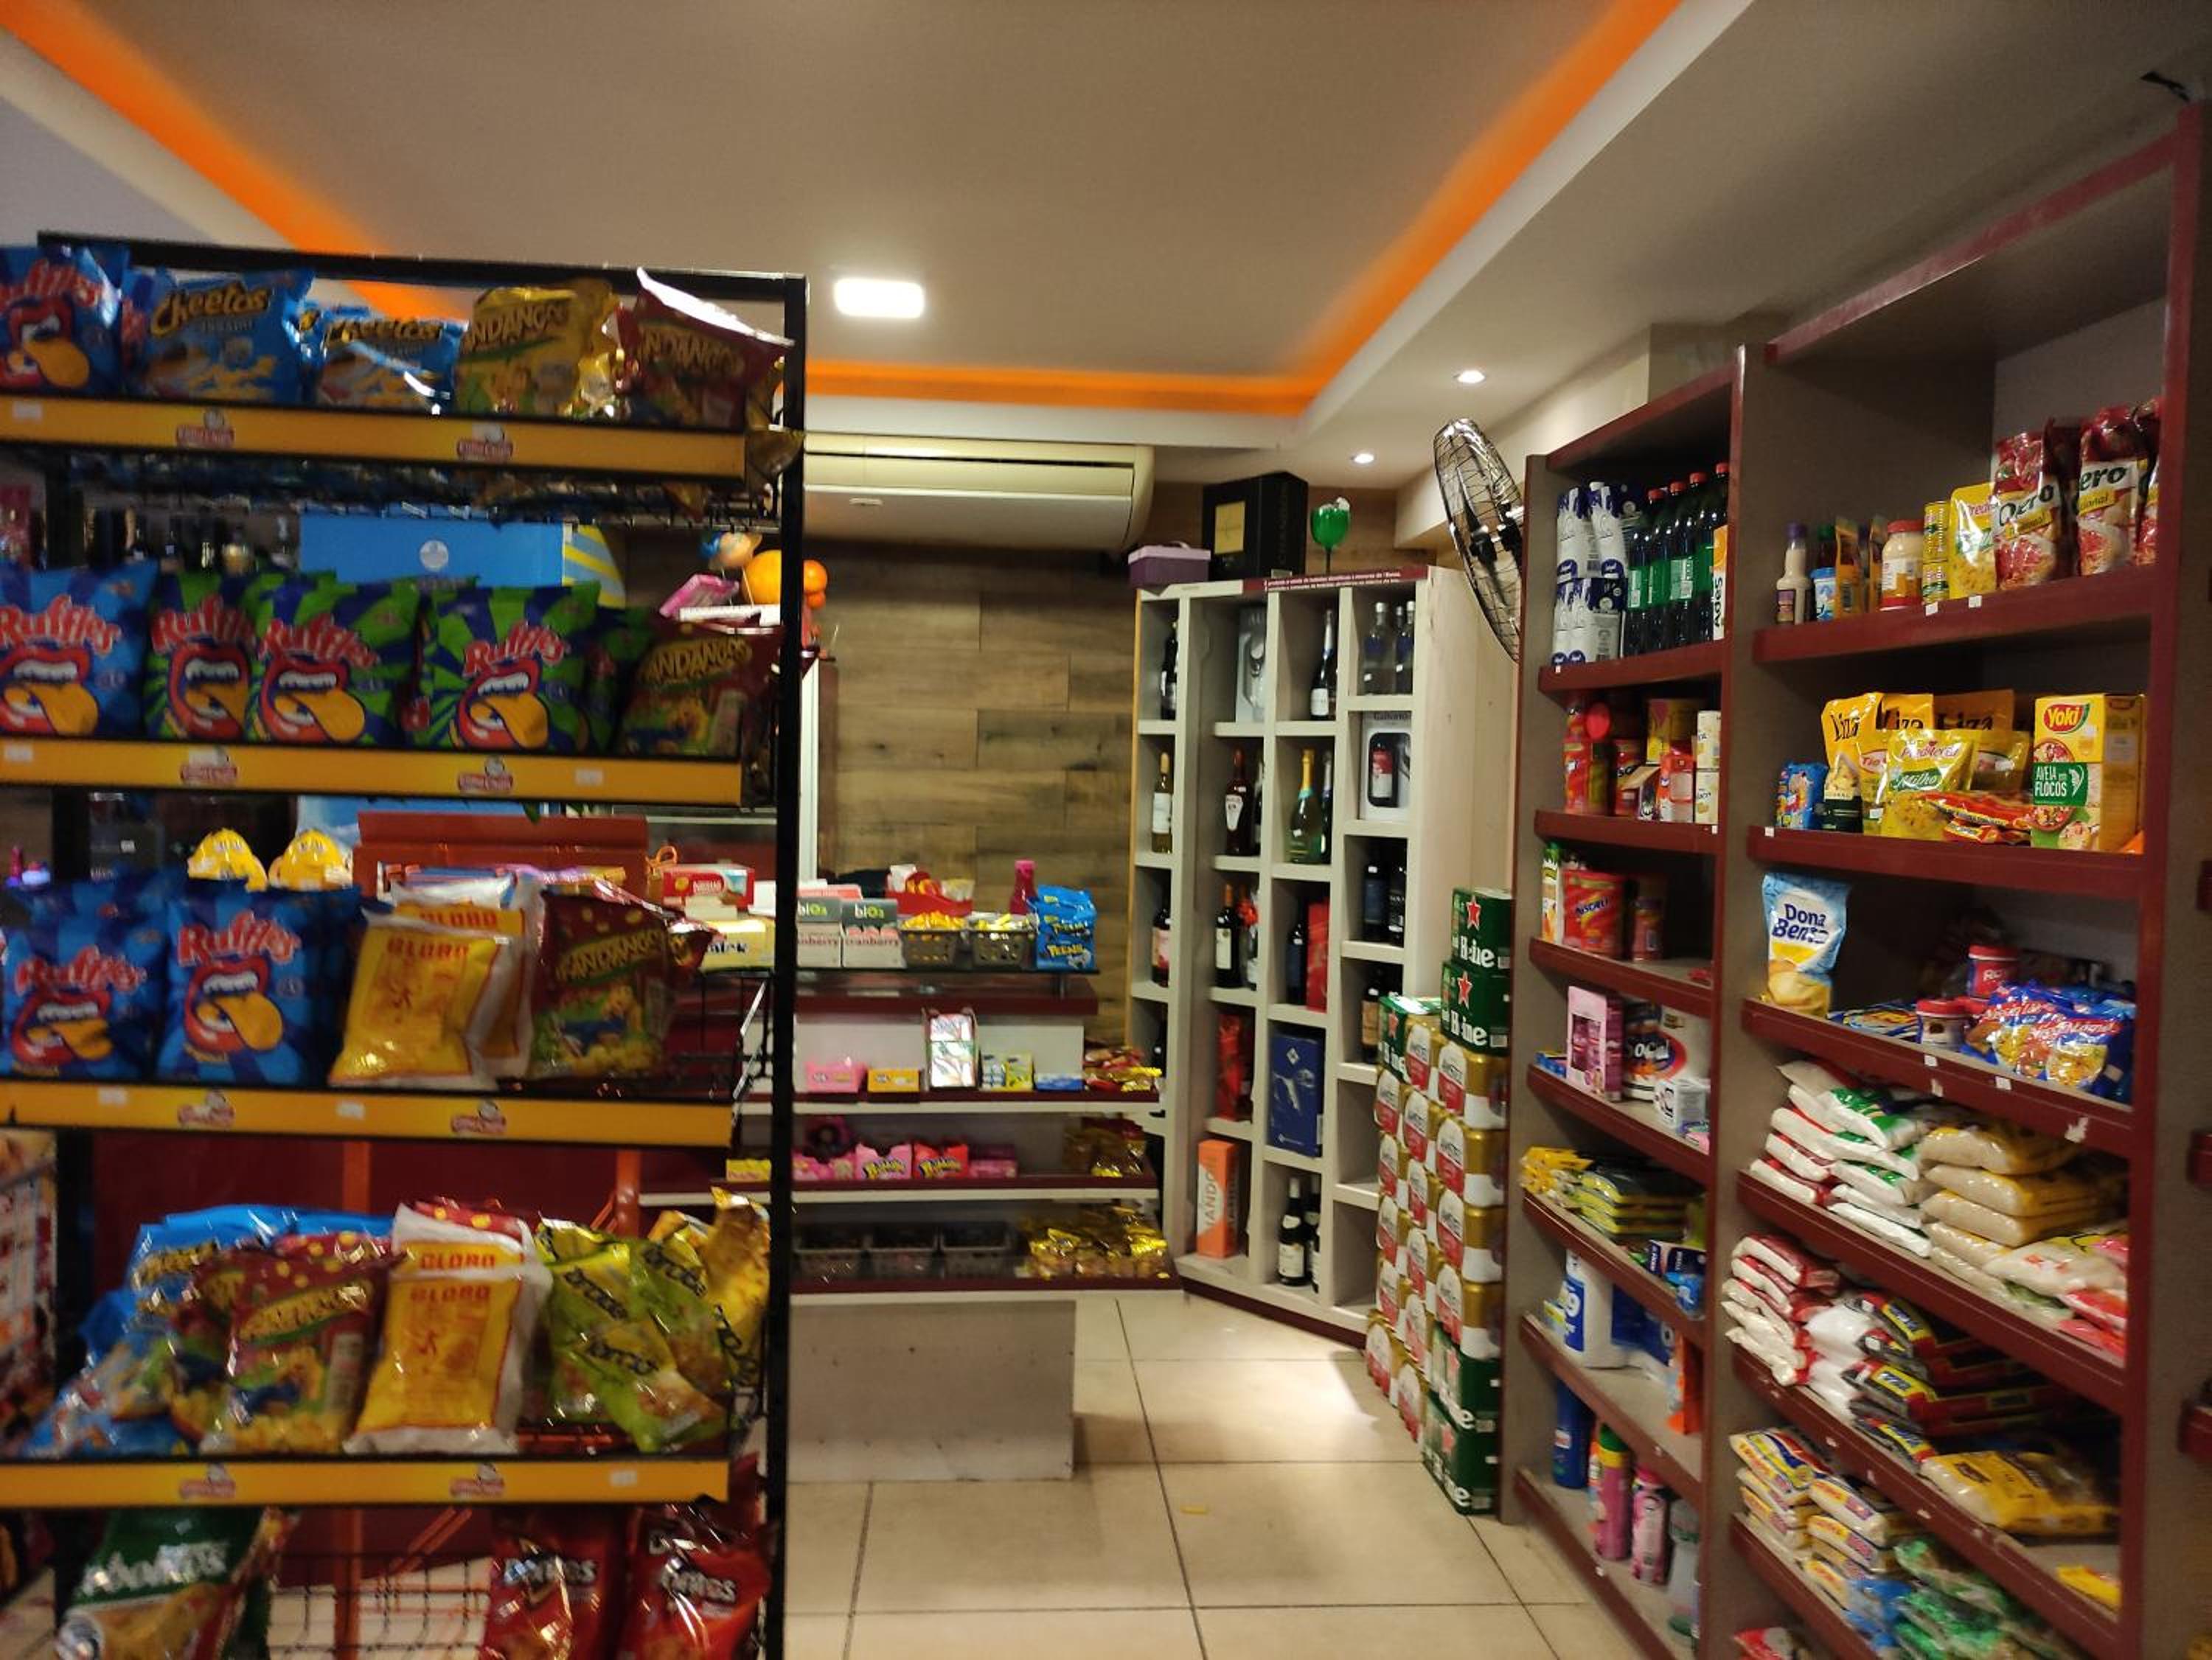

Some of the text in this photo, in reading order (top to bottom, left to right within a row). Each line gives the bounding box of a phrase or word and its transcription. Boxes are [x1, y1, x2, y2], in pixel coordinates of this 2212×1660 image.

[152, 282, 270, 337] Cheetos
[2079, 467, 2128, 492] ero
[2036, 765, 2057, 781] AVEIA
[2034, 781, 2067, 797] FLOCOS
[1784, 903, 1826, 927] Dona
